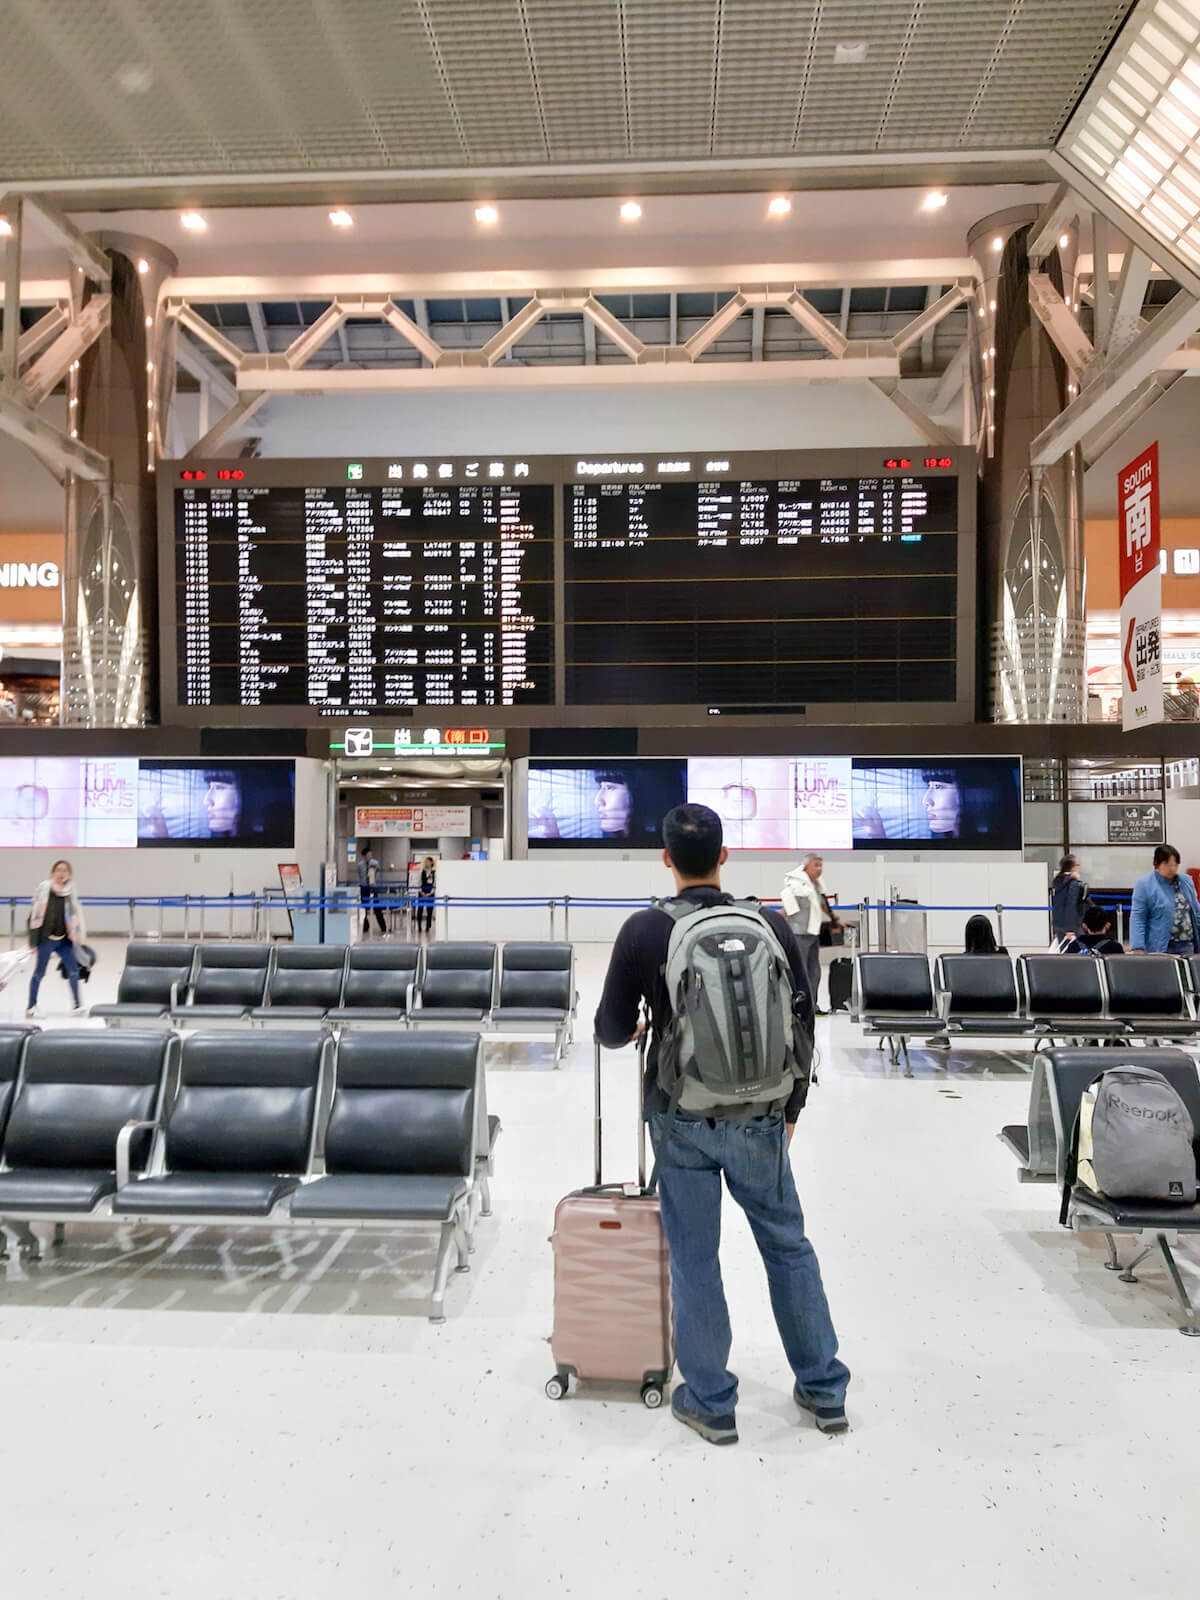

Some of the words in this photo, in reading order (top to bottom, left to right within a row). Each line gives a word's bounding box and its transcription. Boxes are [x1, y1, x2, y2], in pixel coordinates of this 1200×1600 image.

[576, 461, 644, 475] Departures
[1124, 460, 1152, 494] SOUTH
[1124, 481, 1152, 557] 南
[1136, 629, 1160, 668] 出発
[80, 762, 117, 776] THE
[788, 762, 829, 776] THE
[1109, 1094, 1178, 1125] Reebok
